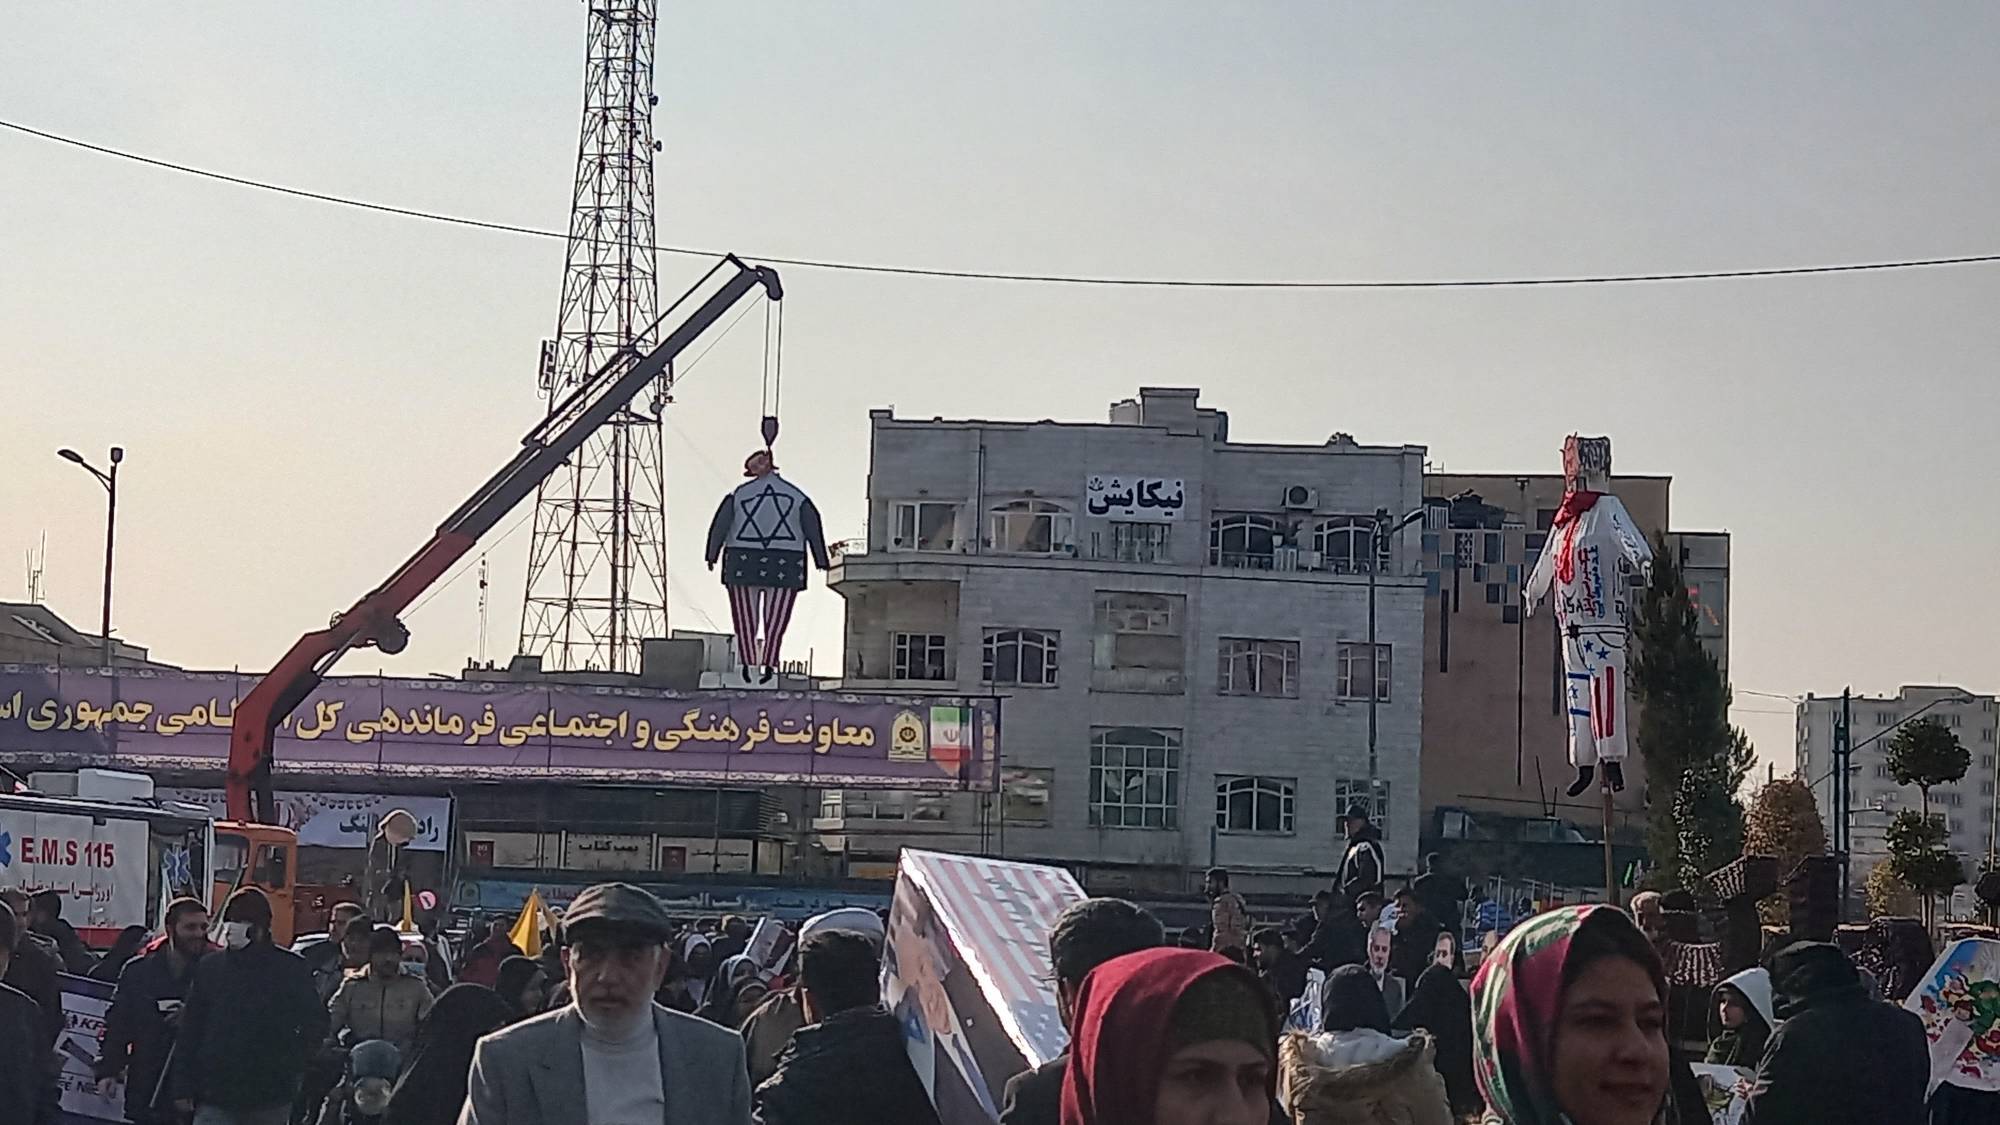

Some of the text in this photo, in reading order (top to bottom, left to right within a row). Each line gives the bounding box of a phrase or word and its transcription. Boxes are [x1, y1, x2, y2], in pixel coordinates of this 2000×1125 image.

[27, 699, 153, 732] جمهوری
[296, 700, 345, 740] کل
[345, 703, 497, 746] فرماندهی
[499, 708, 628, 746] اجتماعی
[632, 720, 650, 749] و
[653, 707, 770, 751] فرهنگی
[774, 715, 875, 753] معاونت
[21, 837, 114, 868] E.M.S 115
